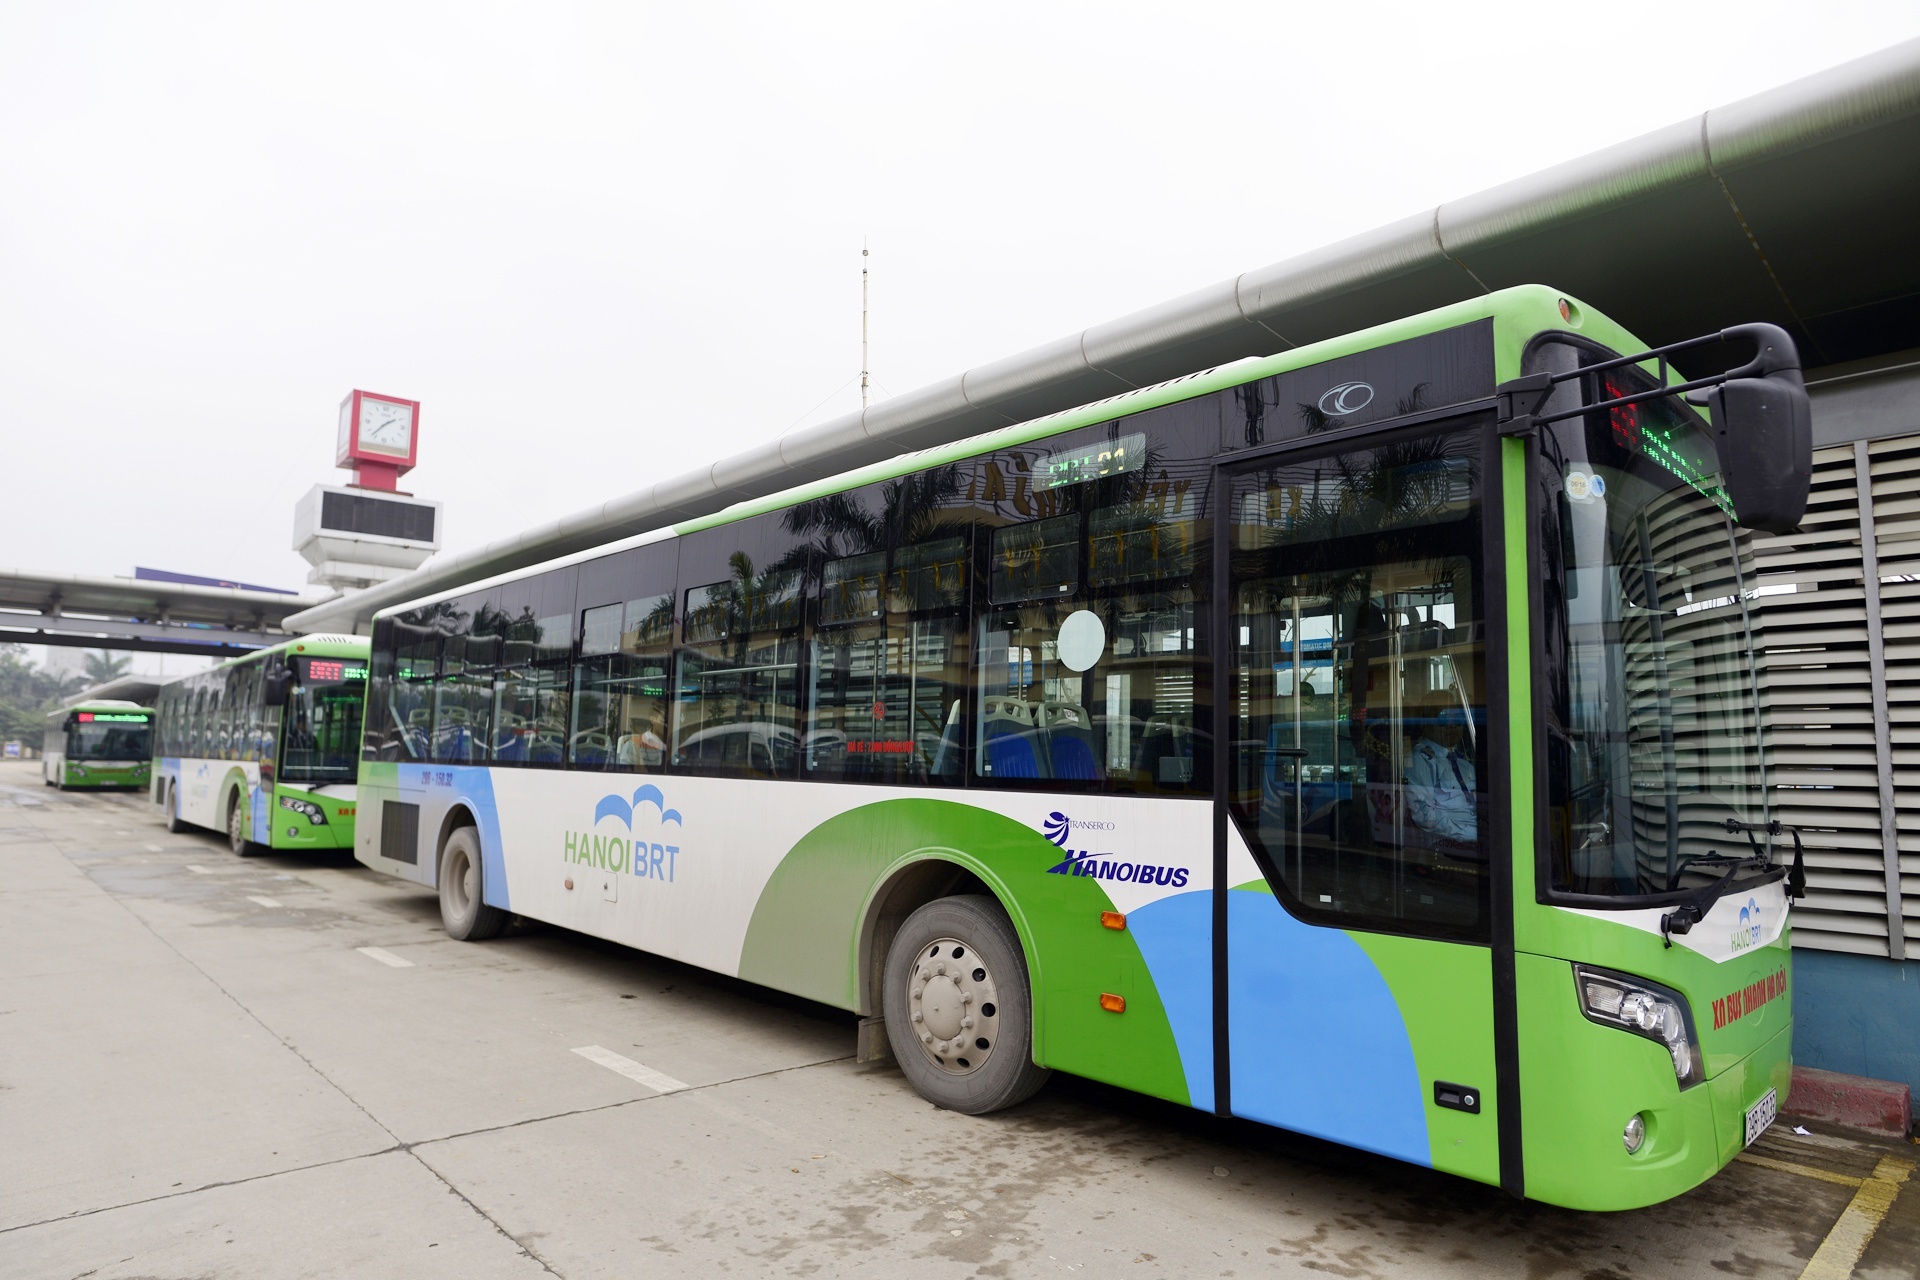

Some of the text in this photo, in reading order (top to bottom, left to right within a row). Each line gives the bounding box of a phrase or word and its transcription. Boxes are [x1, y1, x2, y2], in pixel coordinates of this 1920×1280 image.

[1070, 820, 1115, 832] TRANSERCO
[1046, 849, 1190, 888] HANOIBUS
[1712, 997, 1726, 1031] XN
[1726, 989, 1742, 1024] BUS
